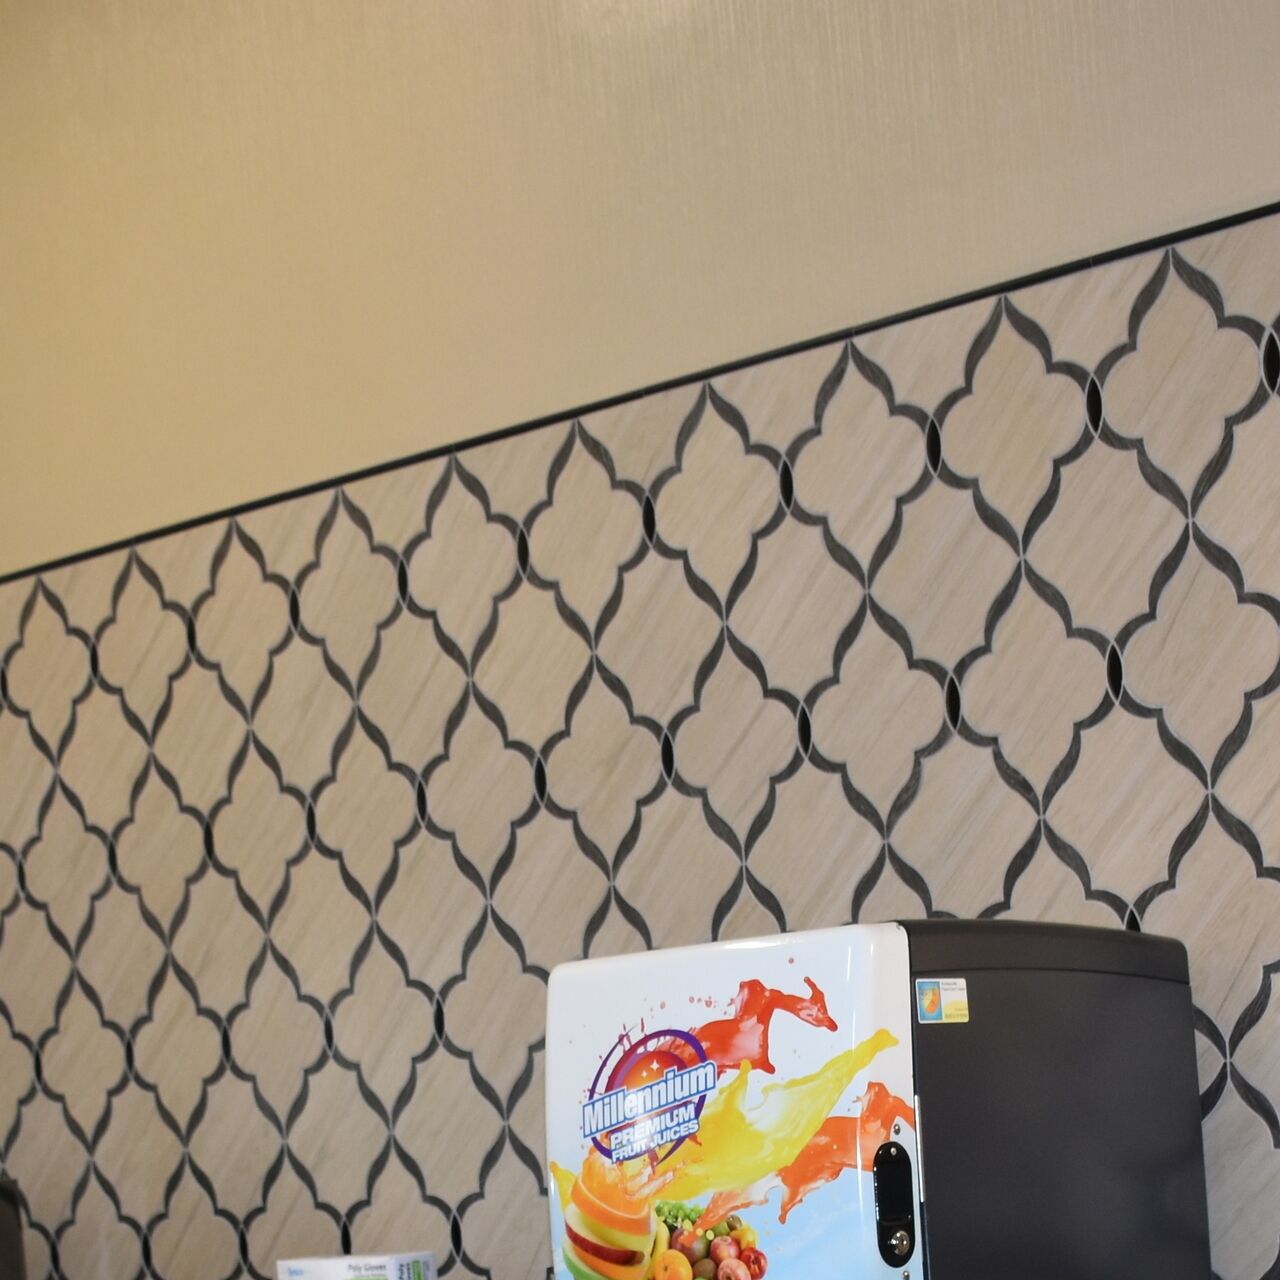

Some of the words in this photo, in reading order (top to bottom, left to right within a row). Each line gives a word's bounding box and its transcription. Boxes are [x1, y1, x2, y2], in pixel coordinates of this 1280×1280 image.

[583, 1061, 716, 1138] Millennium
[610, 1102, 696, 1149] PREMIUM
[612, 1139, 649, 1164] FRUIT
[649, 1120, 699, 1149] JUICES
